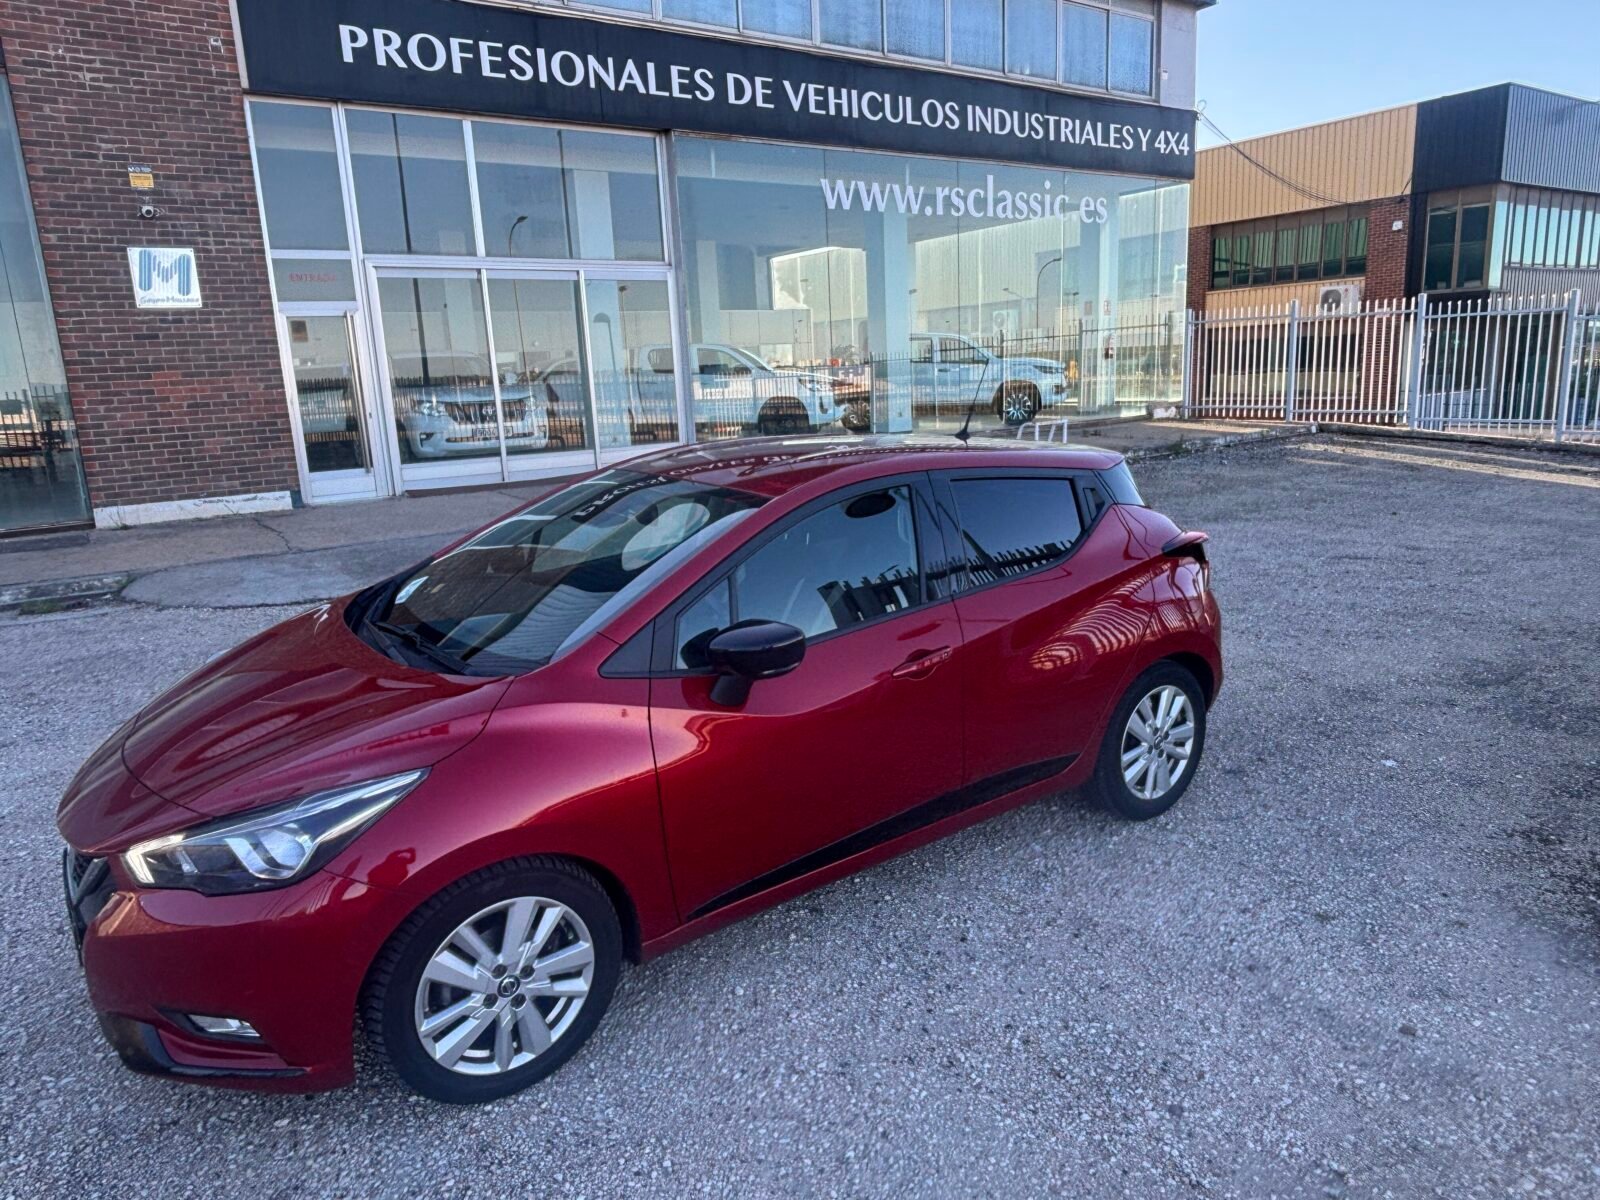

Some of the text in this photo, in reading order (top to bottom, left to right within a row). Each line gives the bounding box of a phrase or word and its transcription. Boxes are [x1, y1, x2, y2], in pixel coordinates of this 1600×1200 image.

[338, 24, 1191, 157] PROFESIONALES DE VEHICULOS INDUSTRIALES Y 4X4
[819, 174, 1108, 224] www.rsclassic.es
